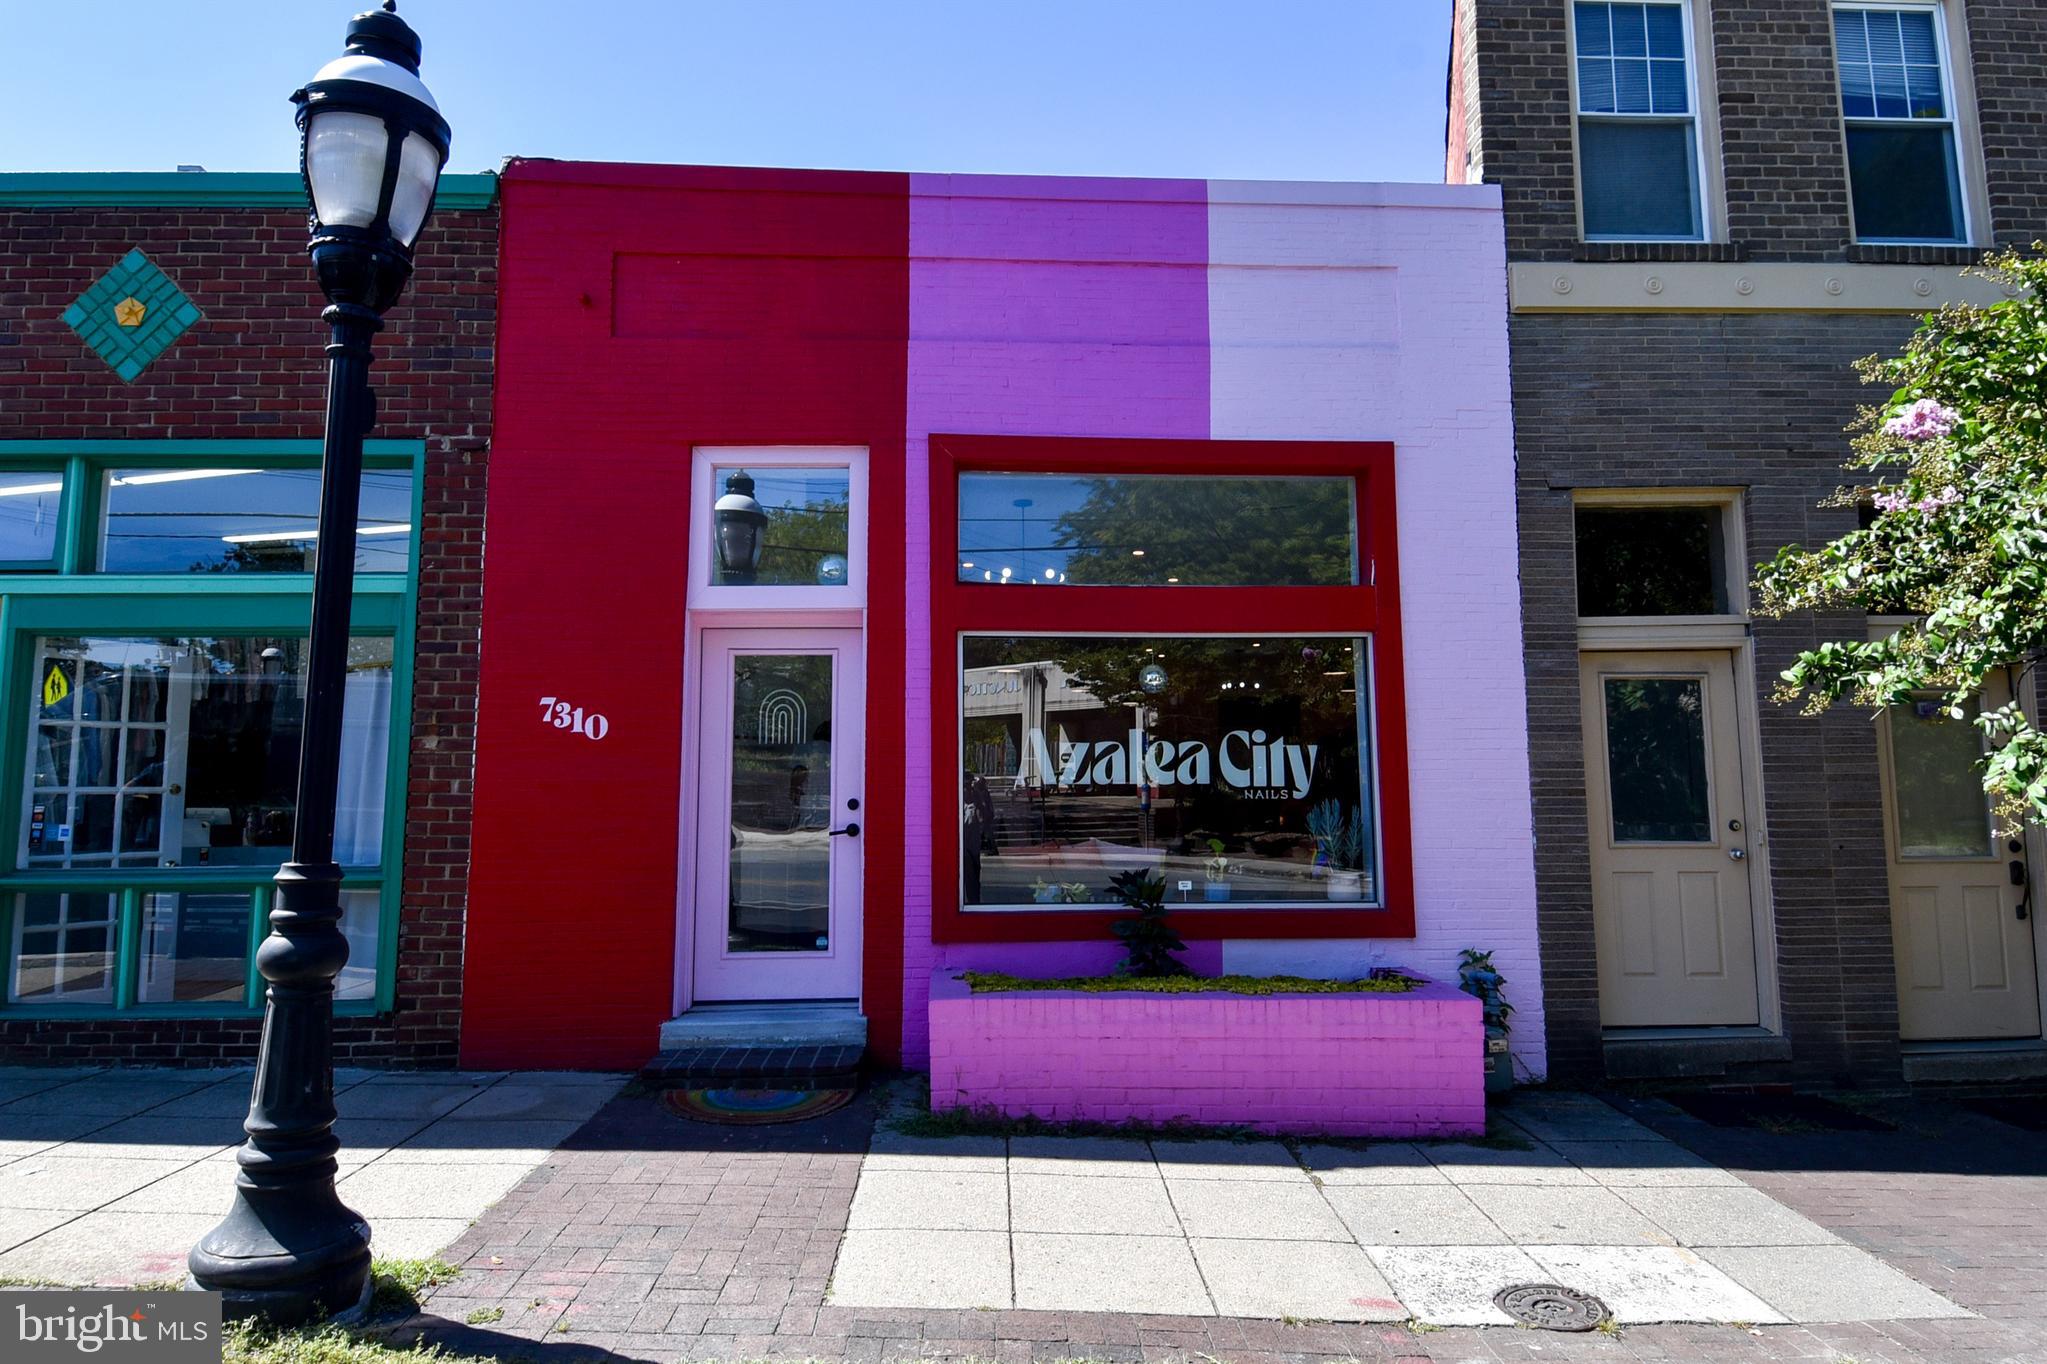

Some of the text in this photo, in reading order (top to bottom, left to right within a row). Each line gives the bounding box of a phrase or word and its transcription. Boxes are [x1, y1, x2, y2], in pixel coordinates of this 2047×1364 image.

[539, 697, 609, 740] 7310
[1014, 727, 1319, 799] Azalea City
[1244, 789, 1289, 800] NAILS
